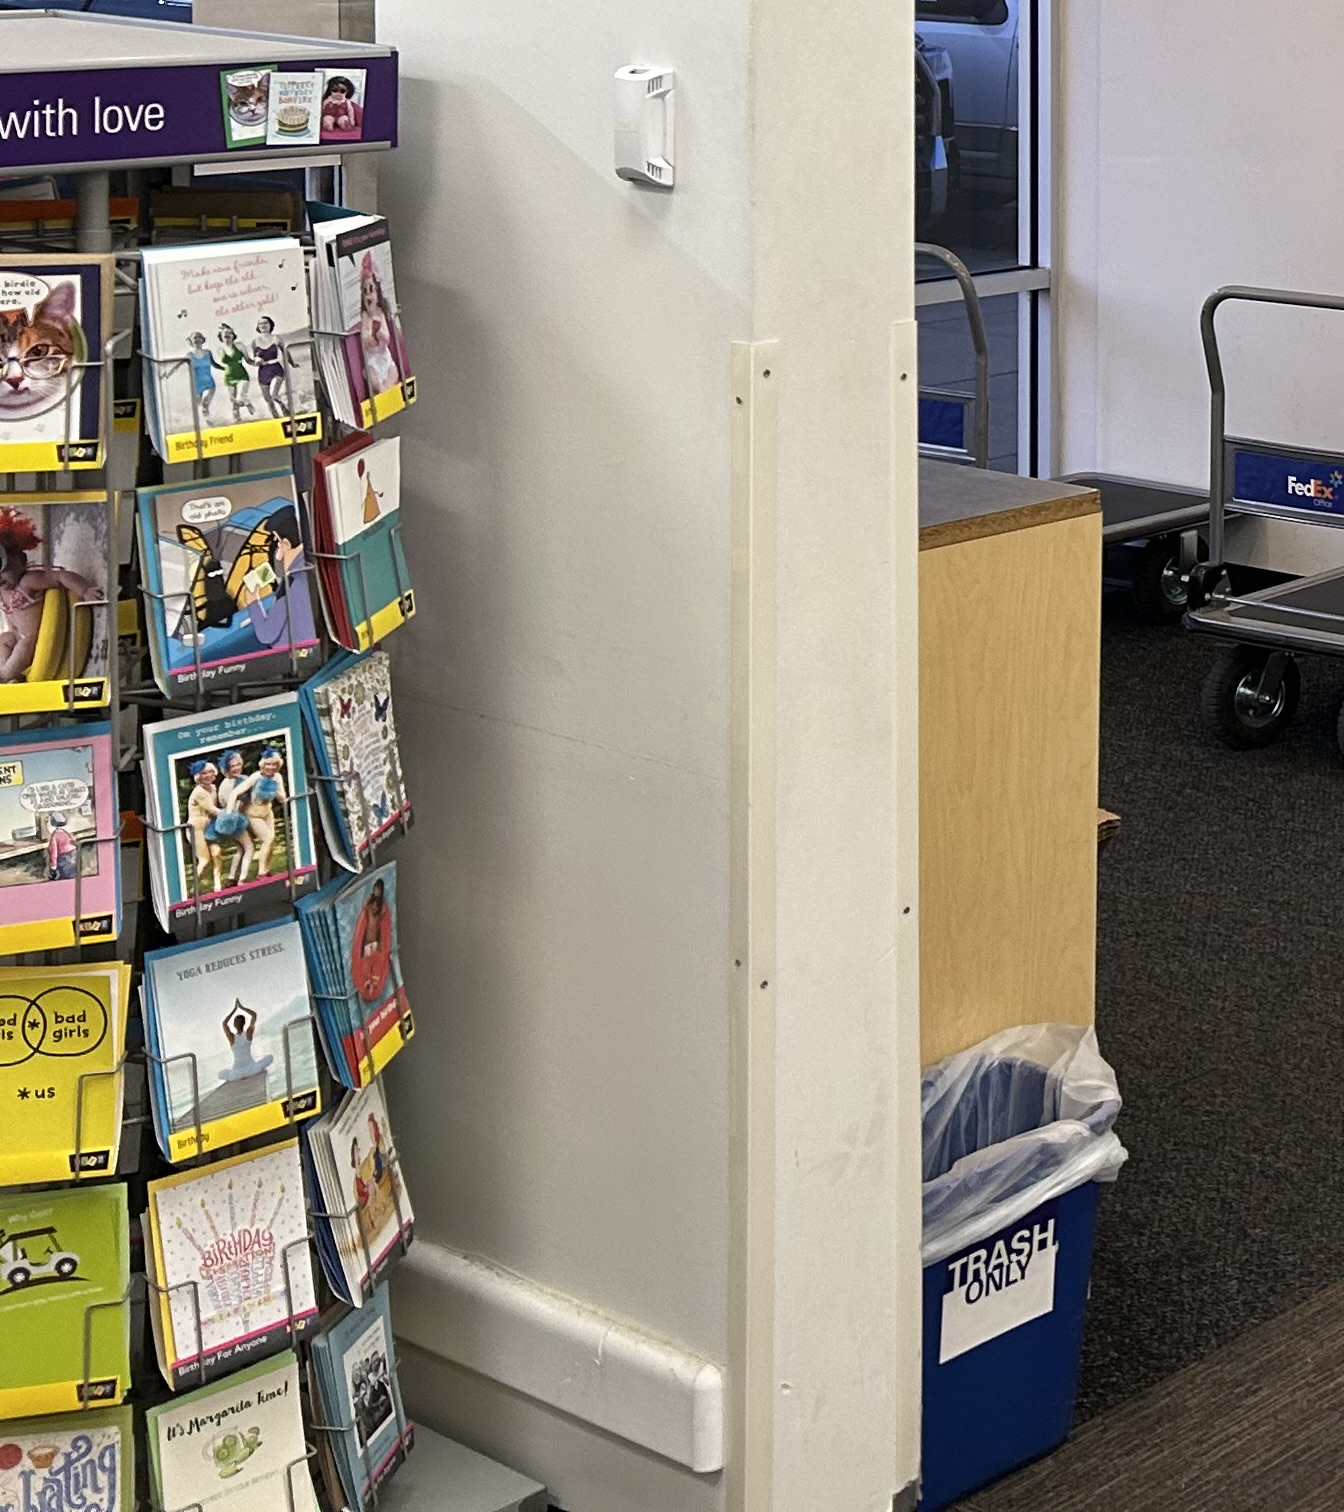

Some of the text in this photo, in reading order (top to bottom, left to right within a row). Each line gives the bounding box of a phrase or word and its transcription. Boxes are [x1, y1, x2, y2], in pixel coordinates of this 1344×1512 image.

[0, 96, 165, 139] with love
[210, 434, 233, 446] Friend
[1287, 476, 1334, 500] FedEx
[1313, 498, 1333, 509] Office
[217, 663, 246, 676] Funny
[195, 724, 220, 737] your
[214, 894, 243, 907] Funny
[176, 943, 285, 982] YOGA REDUCES STRESS
[54, 1010, 86, 1025] bad
[52, 1025, 90, 1042] girls
[948, 1219, 1056, 1291] TRASH
[964, 1256, 1031, 1306] ONLY
[217, 1348, 232, 1360] For
[234, 1335, 268, 1354] Anyone
[166, 1380, 289, 1441] It's Margarita Time!
